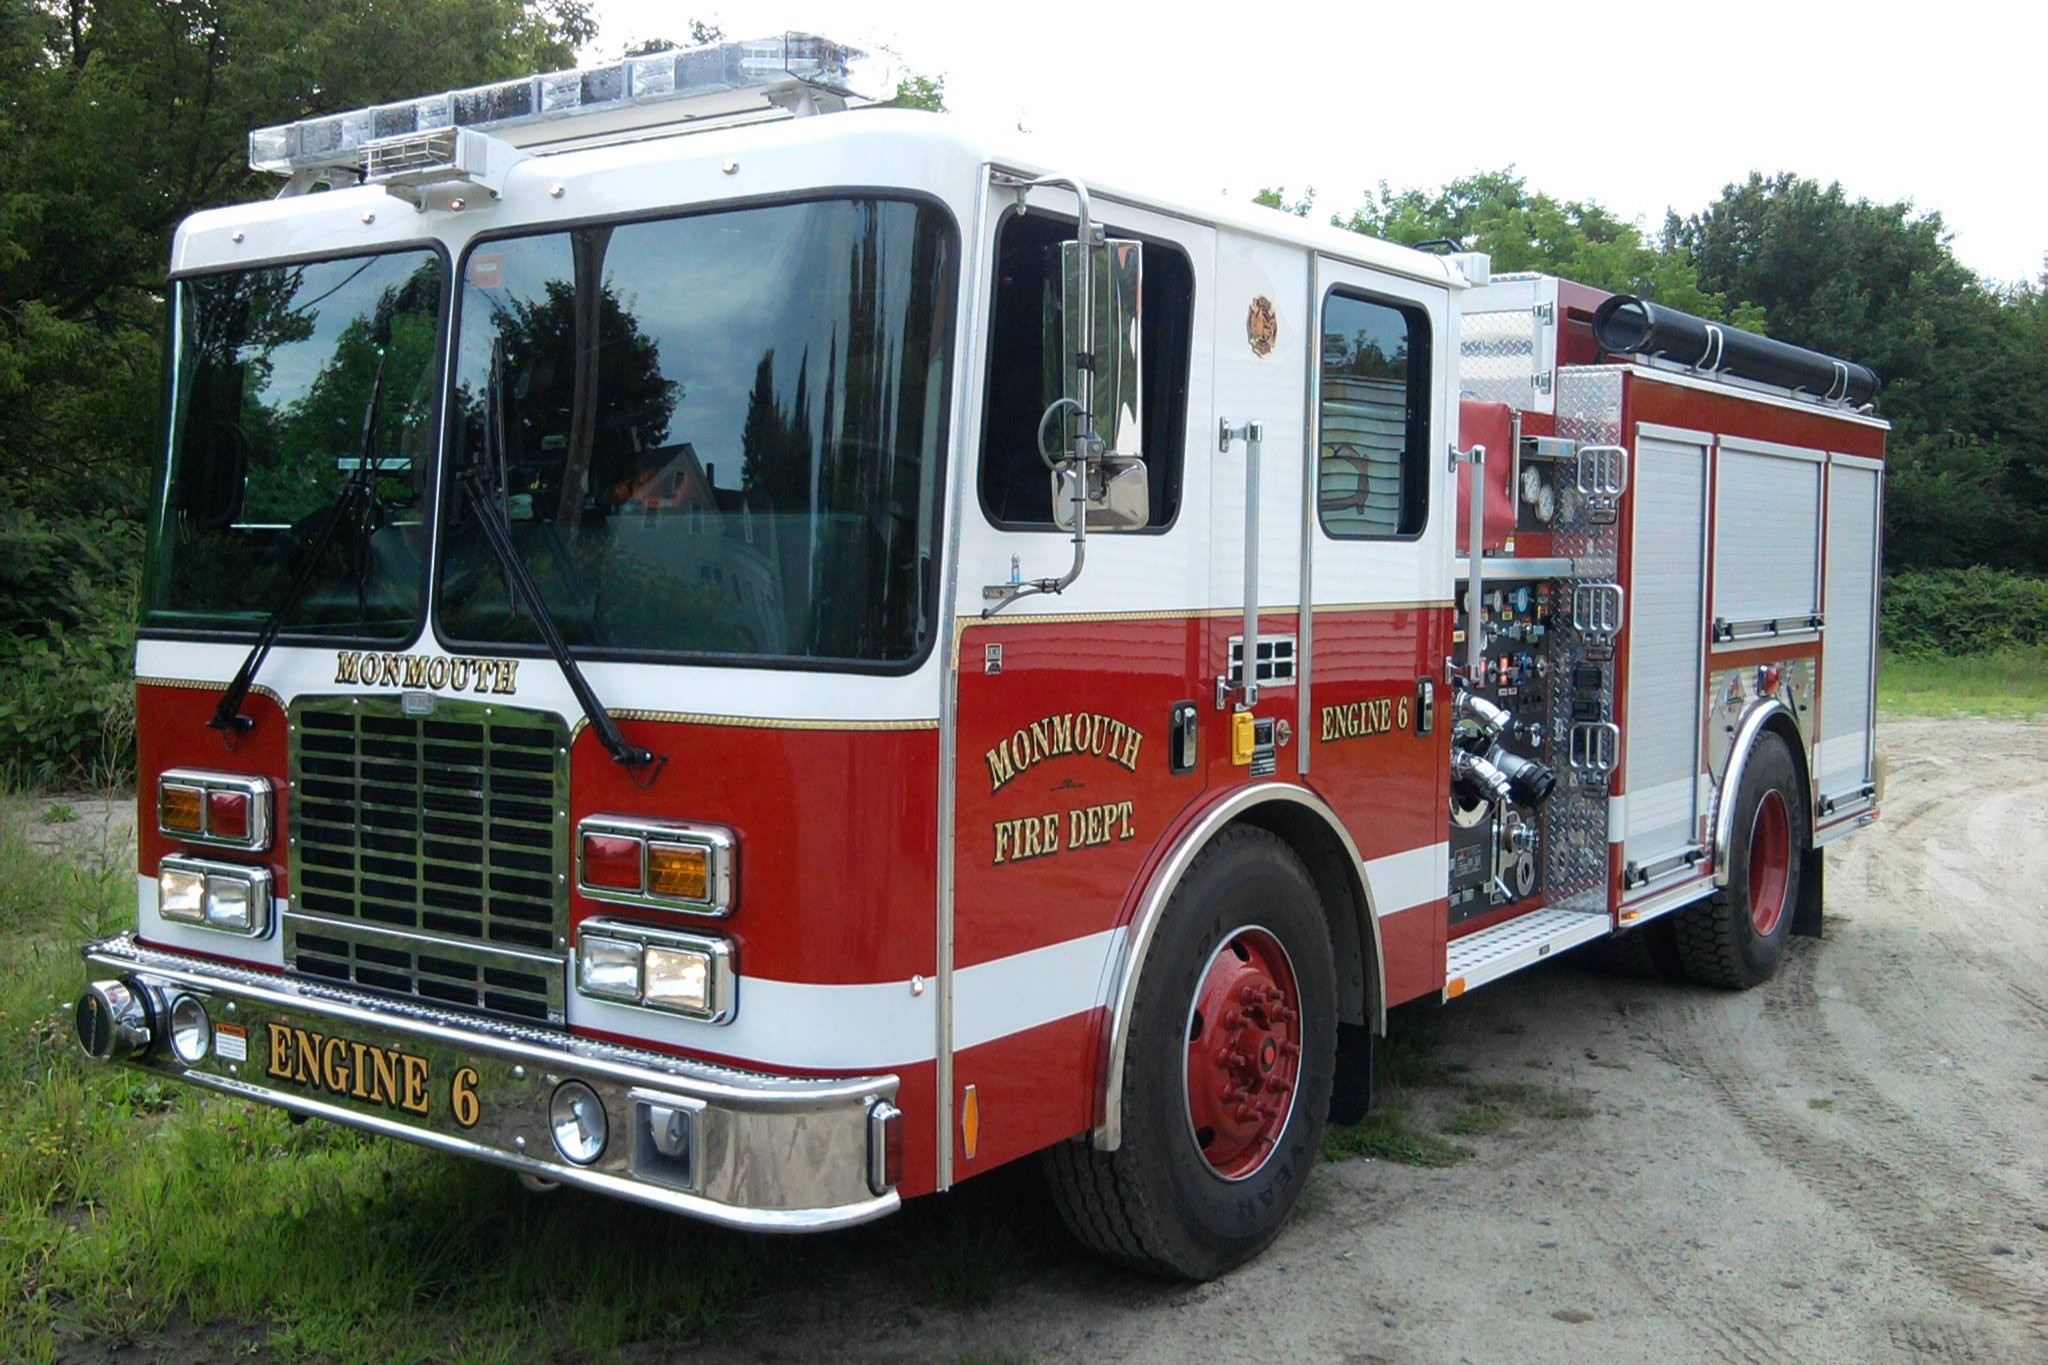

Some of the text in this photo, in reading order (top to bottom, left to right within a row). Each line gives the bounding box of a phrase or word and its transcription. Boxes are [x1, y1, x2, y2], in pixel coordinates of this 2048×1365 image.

[334, 651, 519, 694] MONMOUTH
[1321, 695, 1409, 742] ENGINE 6
[985, 711, 1143, 794] MONMOUTH
[993, 800, 1136, 864] FIRE DEPT.
[266, 1022, 481, 1129] ENGINE 6
